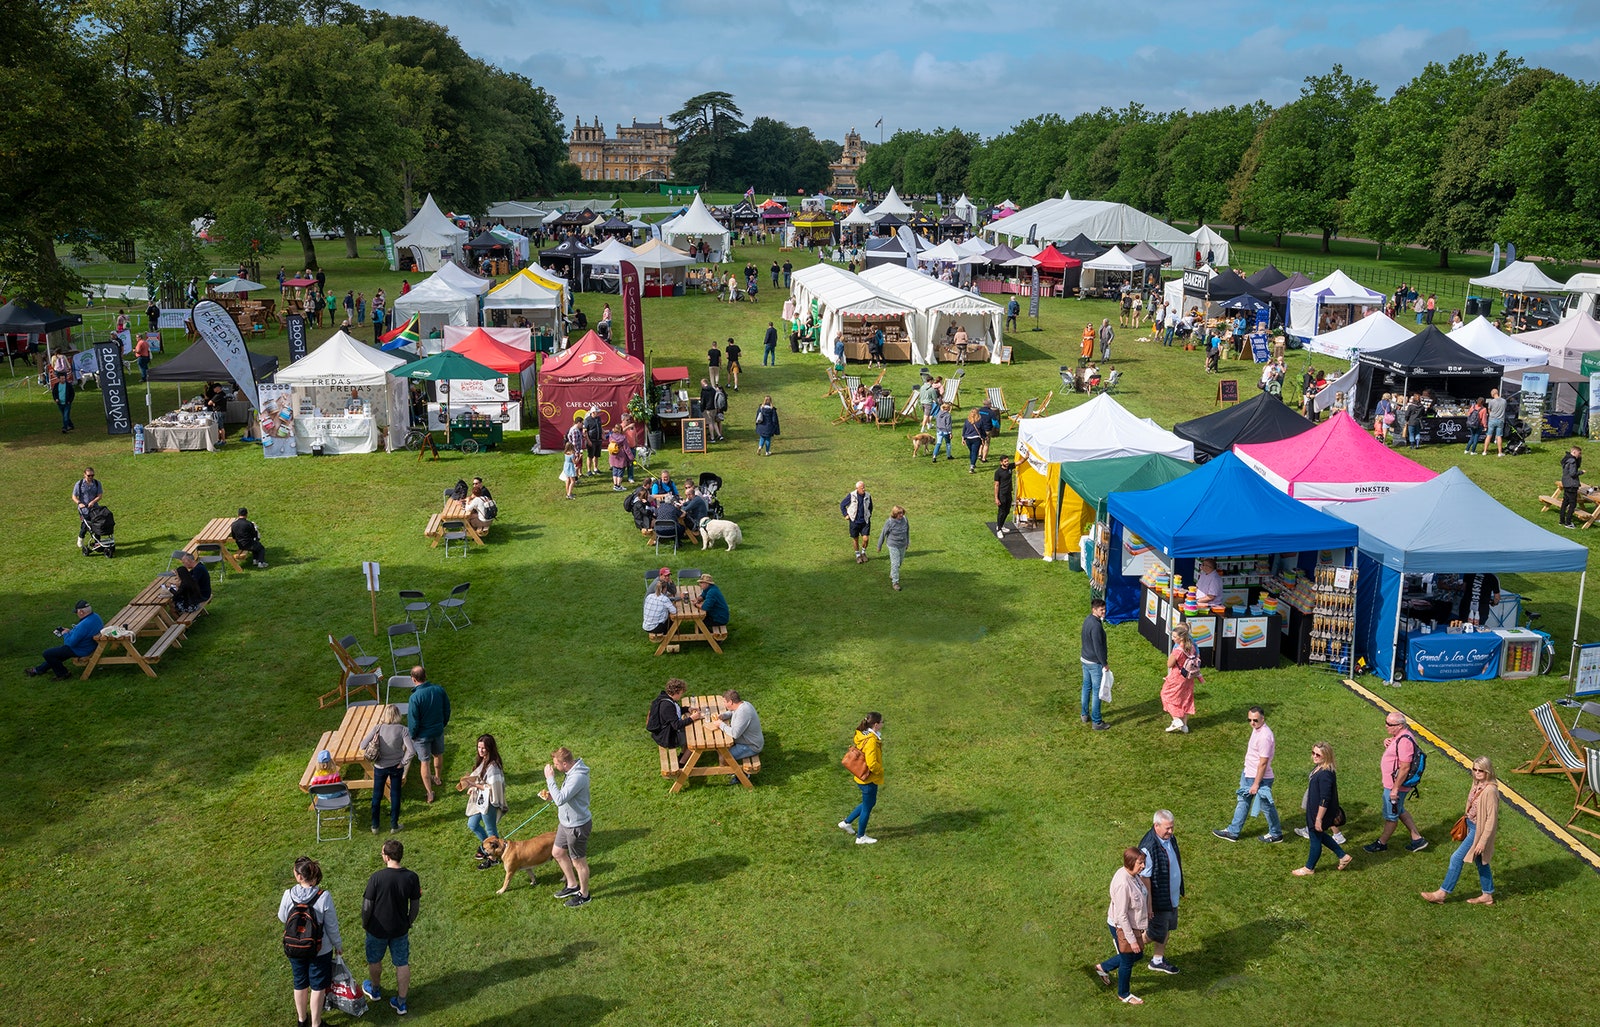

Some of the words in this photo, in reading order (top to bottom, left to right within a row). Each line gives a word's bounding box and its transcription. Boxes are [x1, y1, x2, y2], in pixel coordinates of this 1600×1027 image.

[1184, 272, 1207, 288] BAKERY
[201, 311, 240, 355] FREDA'S
[628, 287, 636, 350] CANNOLI
[1415, 649, 1449, 663] Carmel's
[1451, 651, 1465, 662] Ice
